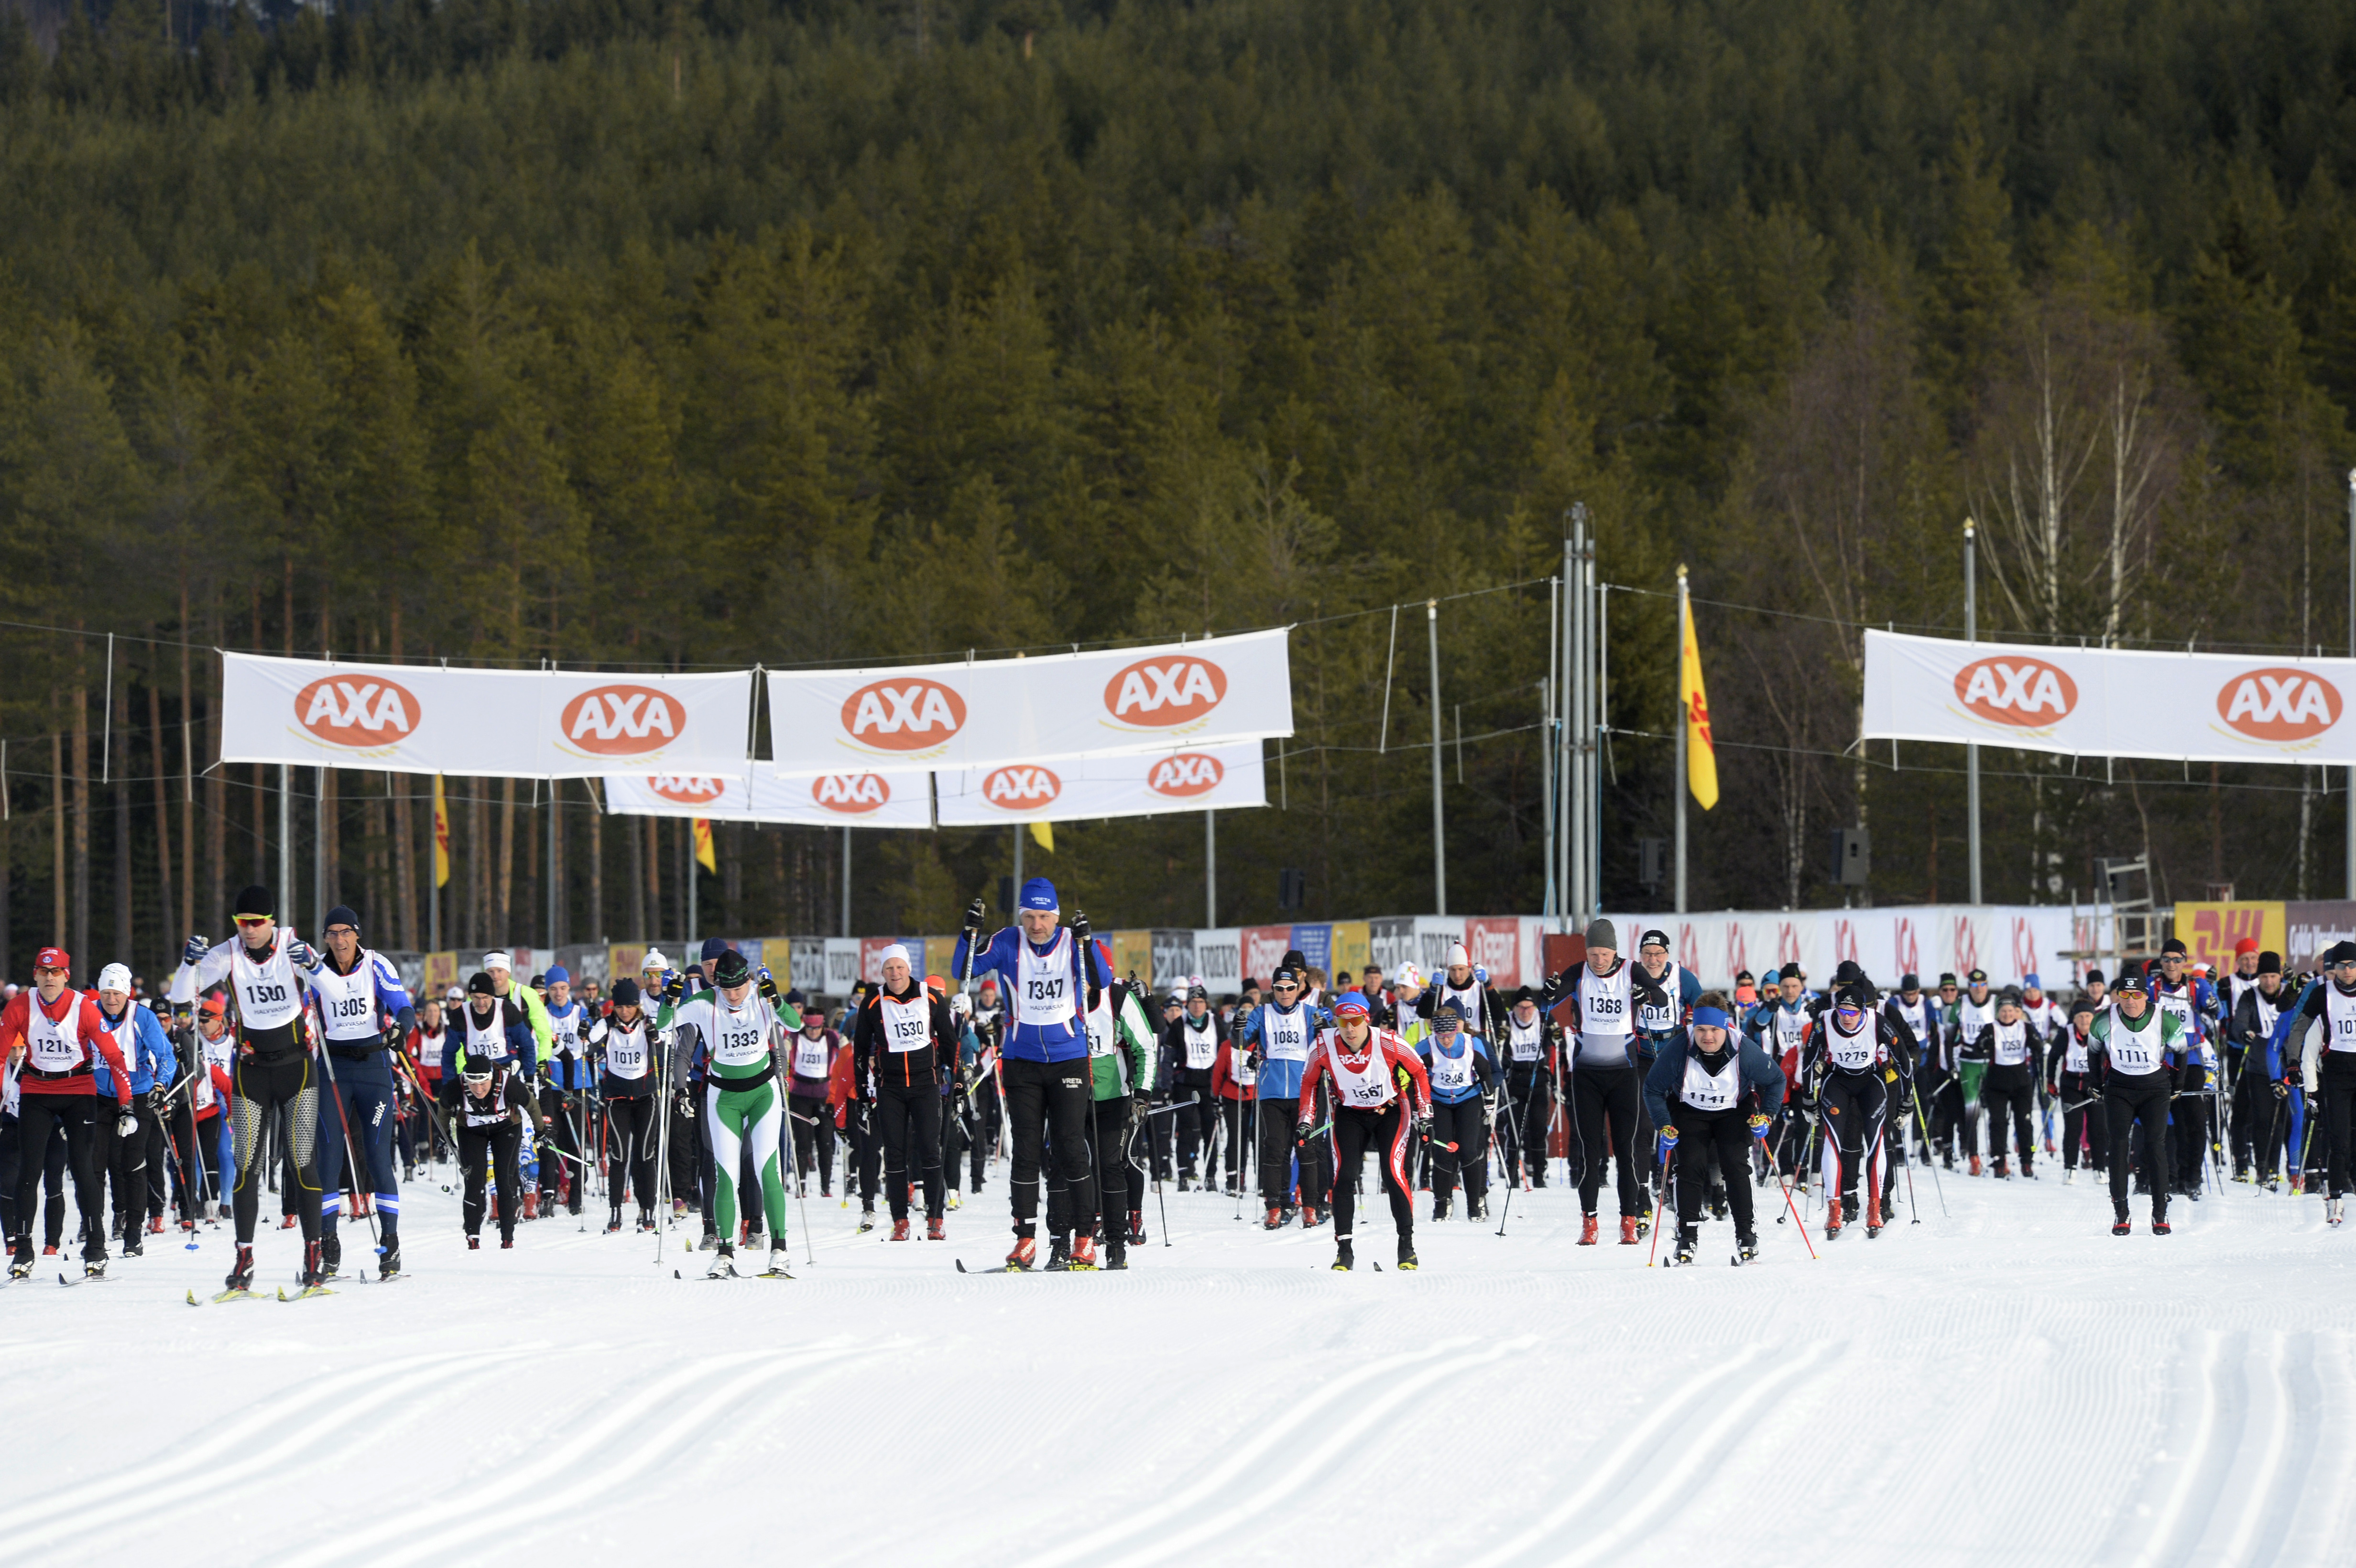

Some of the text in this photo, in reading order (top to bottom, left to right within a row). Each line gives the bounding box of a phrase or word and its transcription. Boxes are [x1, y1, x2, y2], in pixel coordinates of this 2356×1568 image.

[1115, 662, 1218, 715] AXA
[1964, 663, 2066, 714] AXA
[305, 682, 410, 732] AXA
[851, 686, 956, 733] AXA
[2226, 676, 2332, 724] AXA
[571, 693, 674, 739] AXA
[1154, 759, 1218, 788] AXA
[653, 777, 719, 796] AXA
[819, 774, 884, 805] AXA
[989, 772, 1054, 801] AXA
[1028, 978, 1063, 1000] 1347
[331, 997, 367, 1018] 1305
[1590, 997, 1622, 1014] 1368
[722, 1029, 758, 1049] 1333
[894, 1021, 923, 1038] 1530
[1273, 1031, 1299, 1045] 1083
[473, 1043, 498, 1056] 1315
[614, 1051, 640, 1064] 1018
[1516, 1043, 1537, 1053] 1076
[1837, 1051, 1868, 1062] 1279
[2117, 1049, 2149, 1063] 1111
[802, 1053, 820, 1064] 1331
[1353, 1084, 1383, 1100] 1567
[1690, 1092, 1725, 1104] 1141
